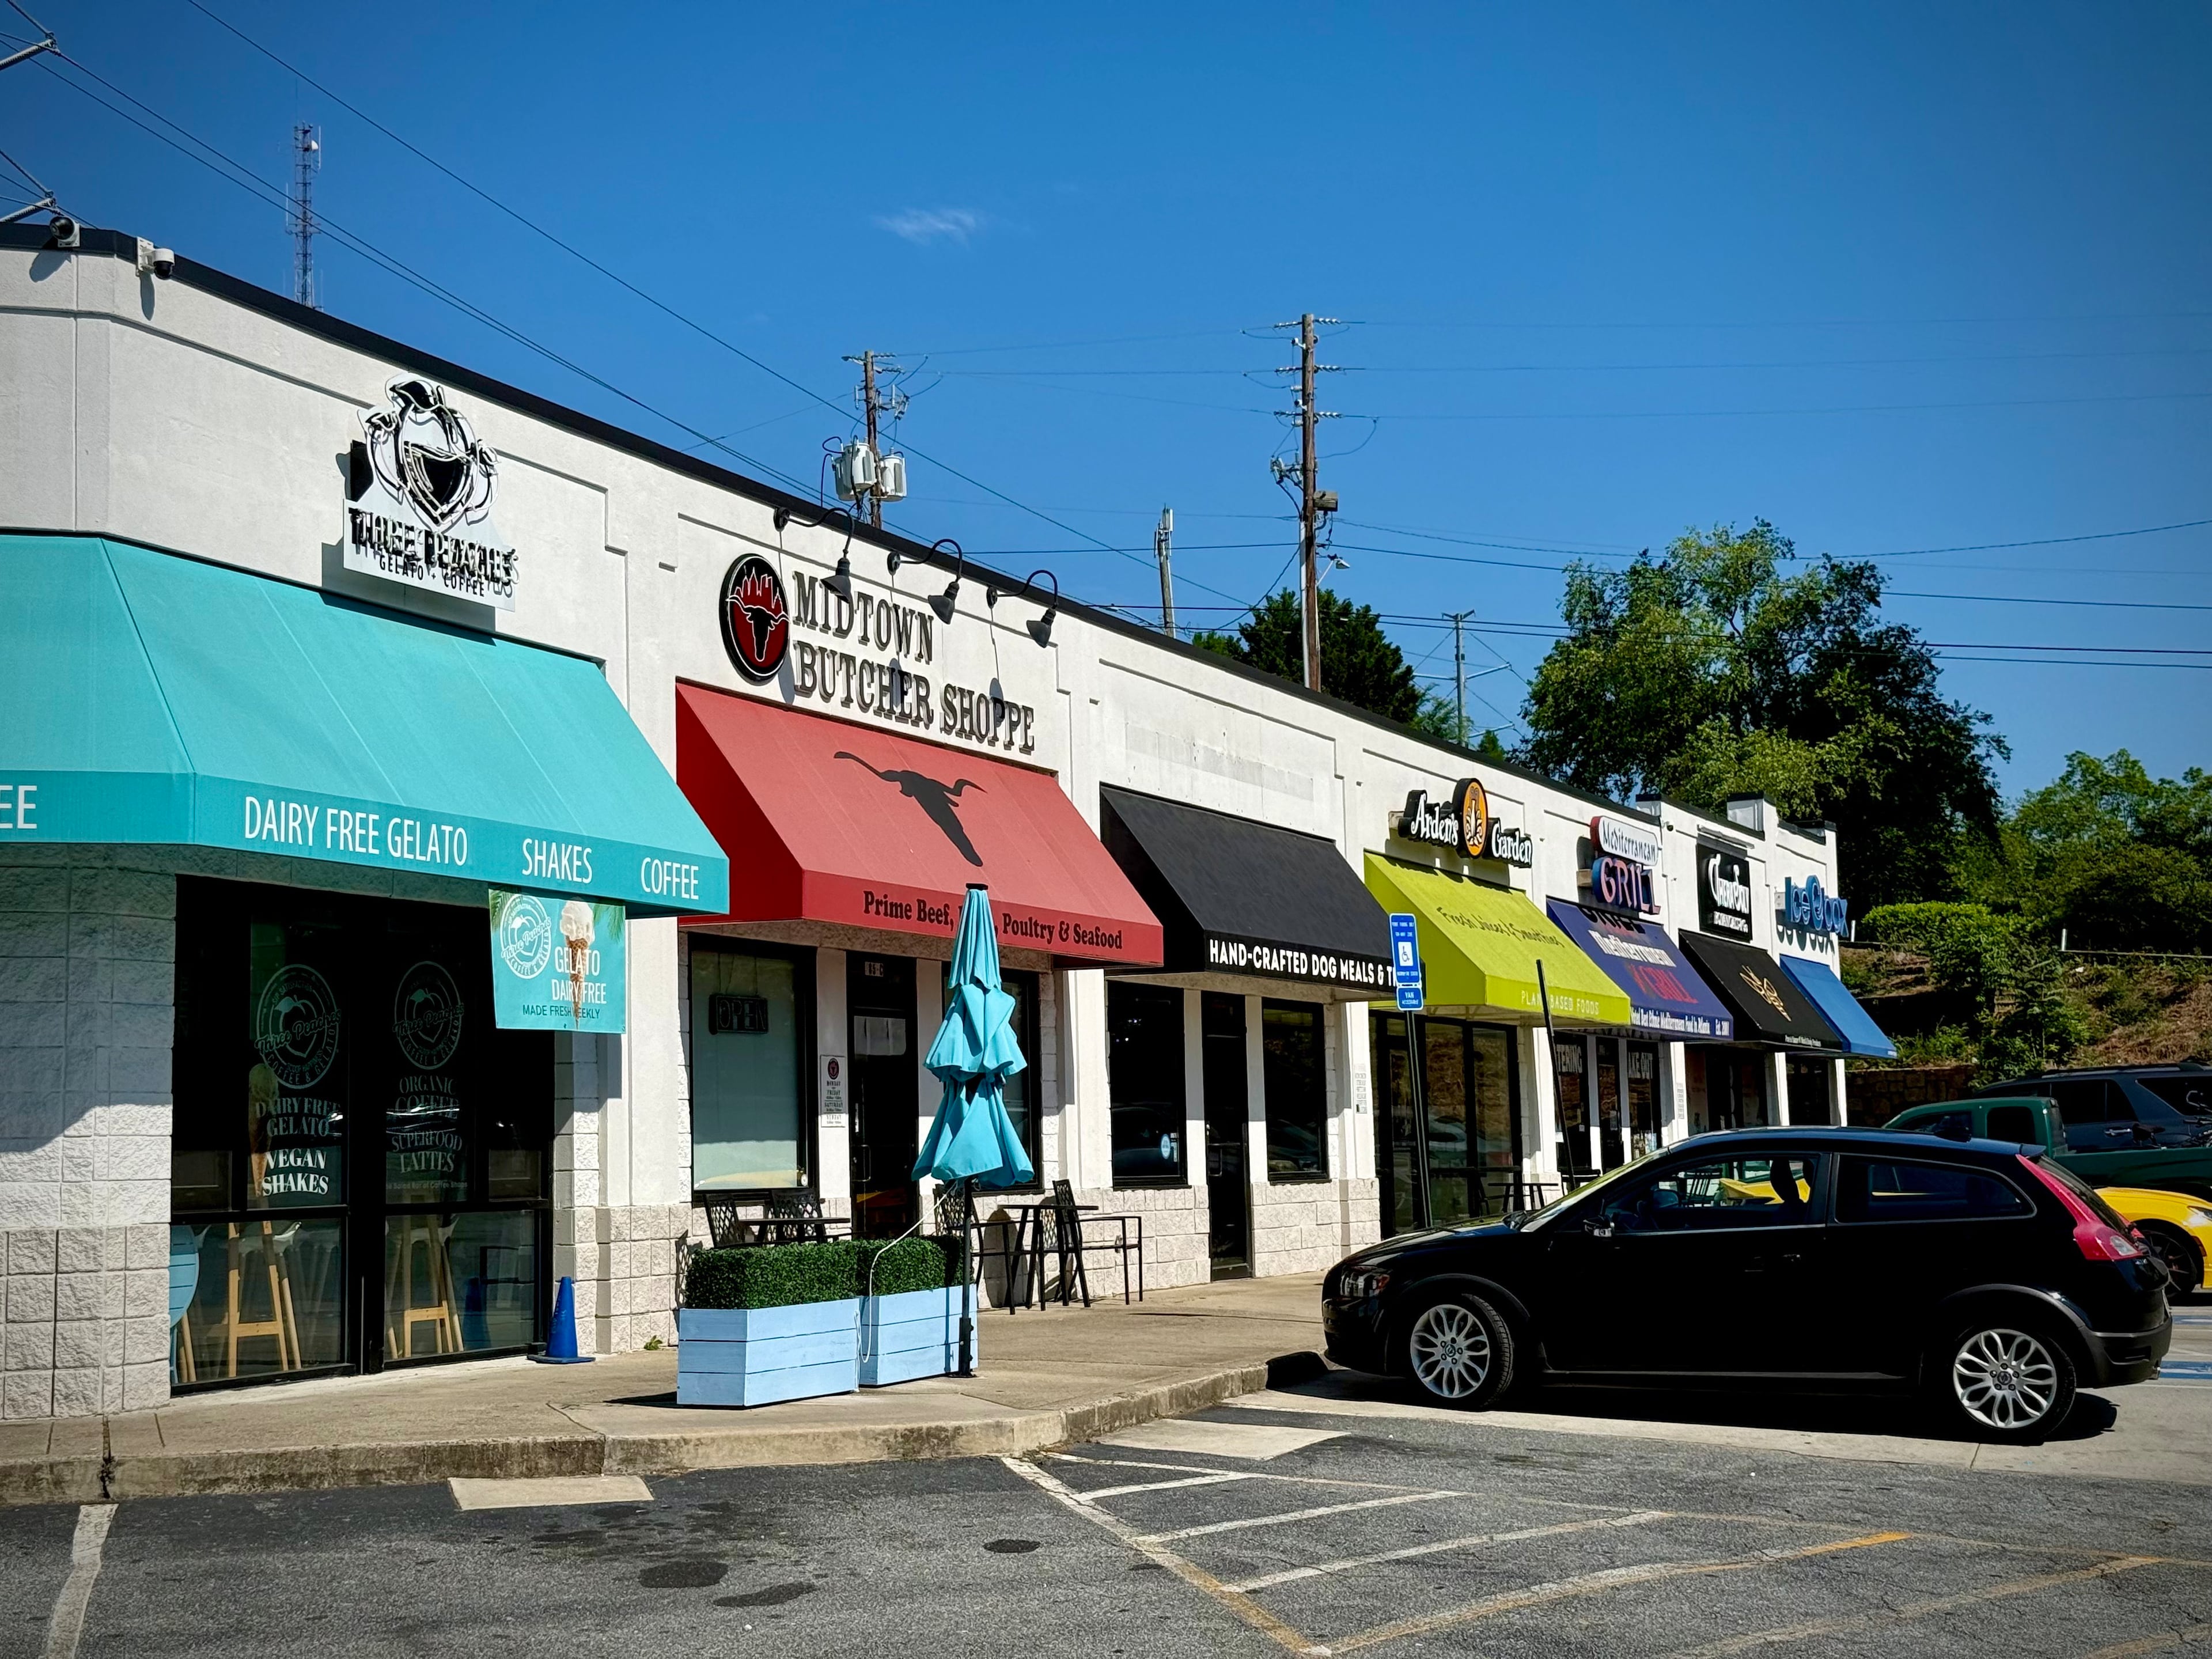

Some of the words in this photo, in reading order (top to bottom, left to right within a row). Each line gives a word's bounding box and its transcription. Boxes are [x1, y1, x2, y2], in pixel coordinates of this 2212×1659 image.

[380, 555, 424, 581] GELATO
[444, 575, 485, 597] COFFEE
[792, 570, 934, 665] MIDTOWN
[793, 640, 934, 730] BUTCHER
[940, 683, 1035, 755] SHOPPE
[0, 786, 37, 829] EE
[1411, 792, 1459, 846] Arden's
[1491, 822, 1532, 864] Garden
[1603, 820, 1656, 862] Mediterranean
[244, 796, 319, 847] DAIRY
[326, 808, 380, 855] FREE
[387, 817, 468, 866] GELATO
[522, 838, 593, 884] SHAKES
[641, 857, 699, 900] COFFEE
[1600, 857, 1661, 915] GRILL
[863, 891, 912, 921] Prime
[916, 898, 954, 931] Beef,
[1002, 912, 1055, 945] Poultry
[1058, 920, 1070, 942] &
[1073, 923, 1123, 950] Seafood
[554, 946, 600, 976] GELATO
[1210, 939, 1308, 975] HAND-CRAFTED
[1311, 954, 1337, 979] DOG
[1340, 957, 1374, 984] MEALS
[1377, 968, 1384, 986] &
[551, 979, 580, 1002] DAIRY
[581, 982, 607, 1004] FREE
[1404, 991, 1415, 999] VAN
[1521, 990, 1543, 1006] PLAN
[1550, 994, 1573, 1012] BASED
[1576, 998, 1599, 1015] FOODS
[522, 1004, 547, 1016] MADE
[550, 1005, 571, 1017] FRESH
[719, 999, 766, 1030] OPEN
[254, 1030, 292, 1056] Three
[293, 1008, 342, 1040] Peaches
[267, 1054, 300, 1085] COFFEE
[1556, 1044, 1583, 1074] TERING
[399, 1075, 457, 1096] ORGANIC
[256, 1097, 302, 1118] DAIRY
[303, 1096, 341, 1116] FREE
[266, 1115, 330, 1138] GELATO
[392, 1129, 463, 1153] SUPERFOOD
[266, 1147, 328, 1170] VEGAN
[400, 1151, 456, 1173] LATTES
[261, 1172, 329, 1197] SHAKES
